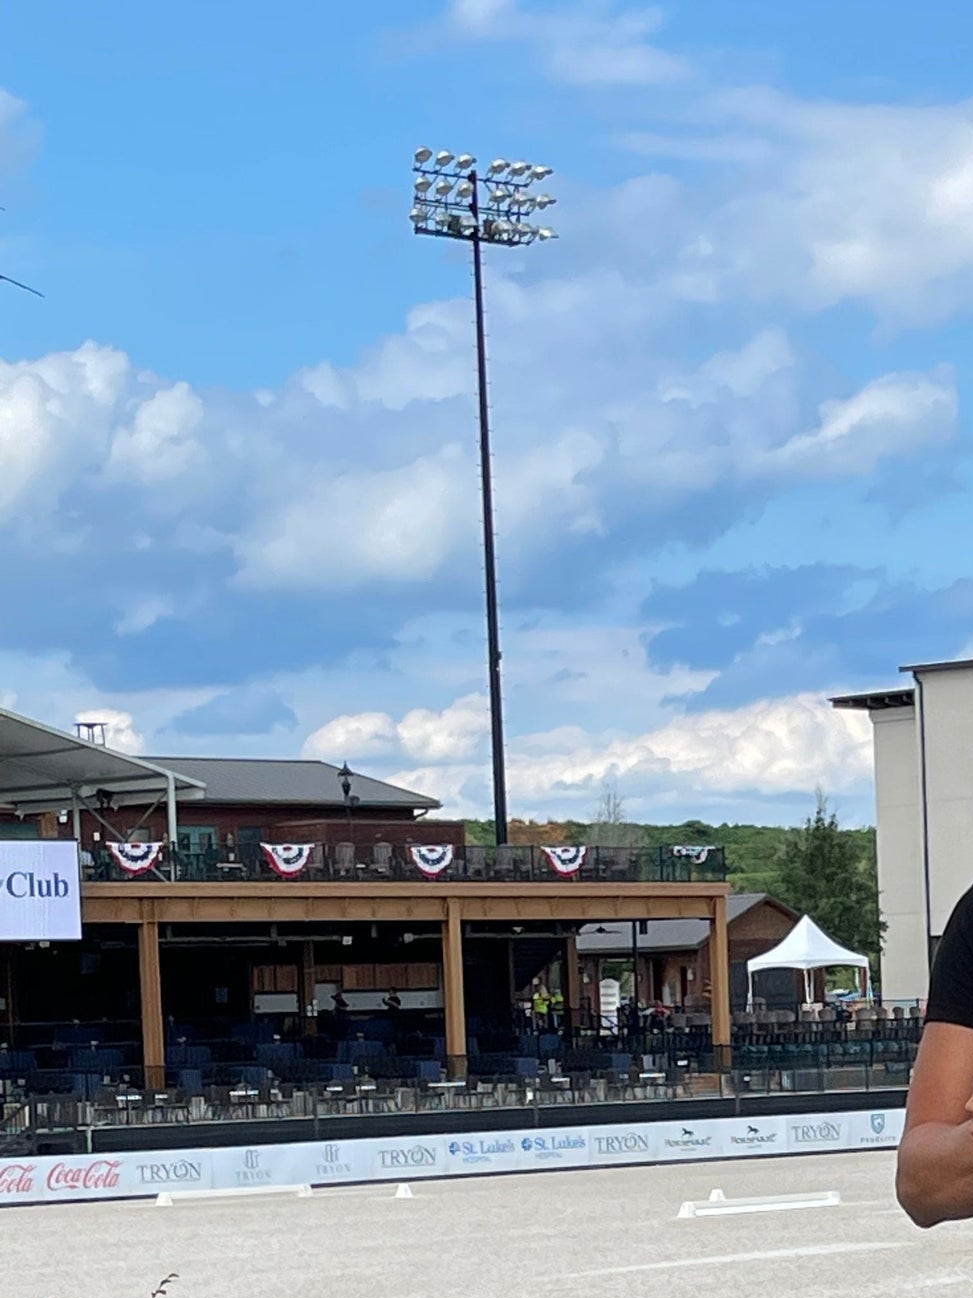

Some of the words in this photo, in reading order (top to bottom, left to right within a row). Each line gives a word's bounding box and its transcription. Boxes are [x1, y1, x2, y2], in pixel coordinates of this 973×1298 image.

[0, 871, 69, 898] Club
[792, 1122, 841, 1141] TRYON
[551, 1135, 586, 1149] Luke's
[595, 1133, 649, 1152] TRYON
[378, 1145, 436, 1165] TRYON
[137, 1160, 201, 1181] TRYON
